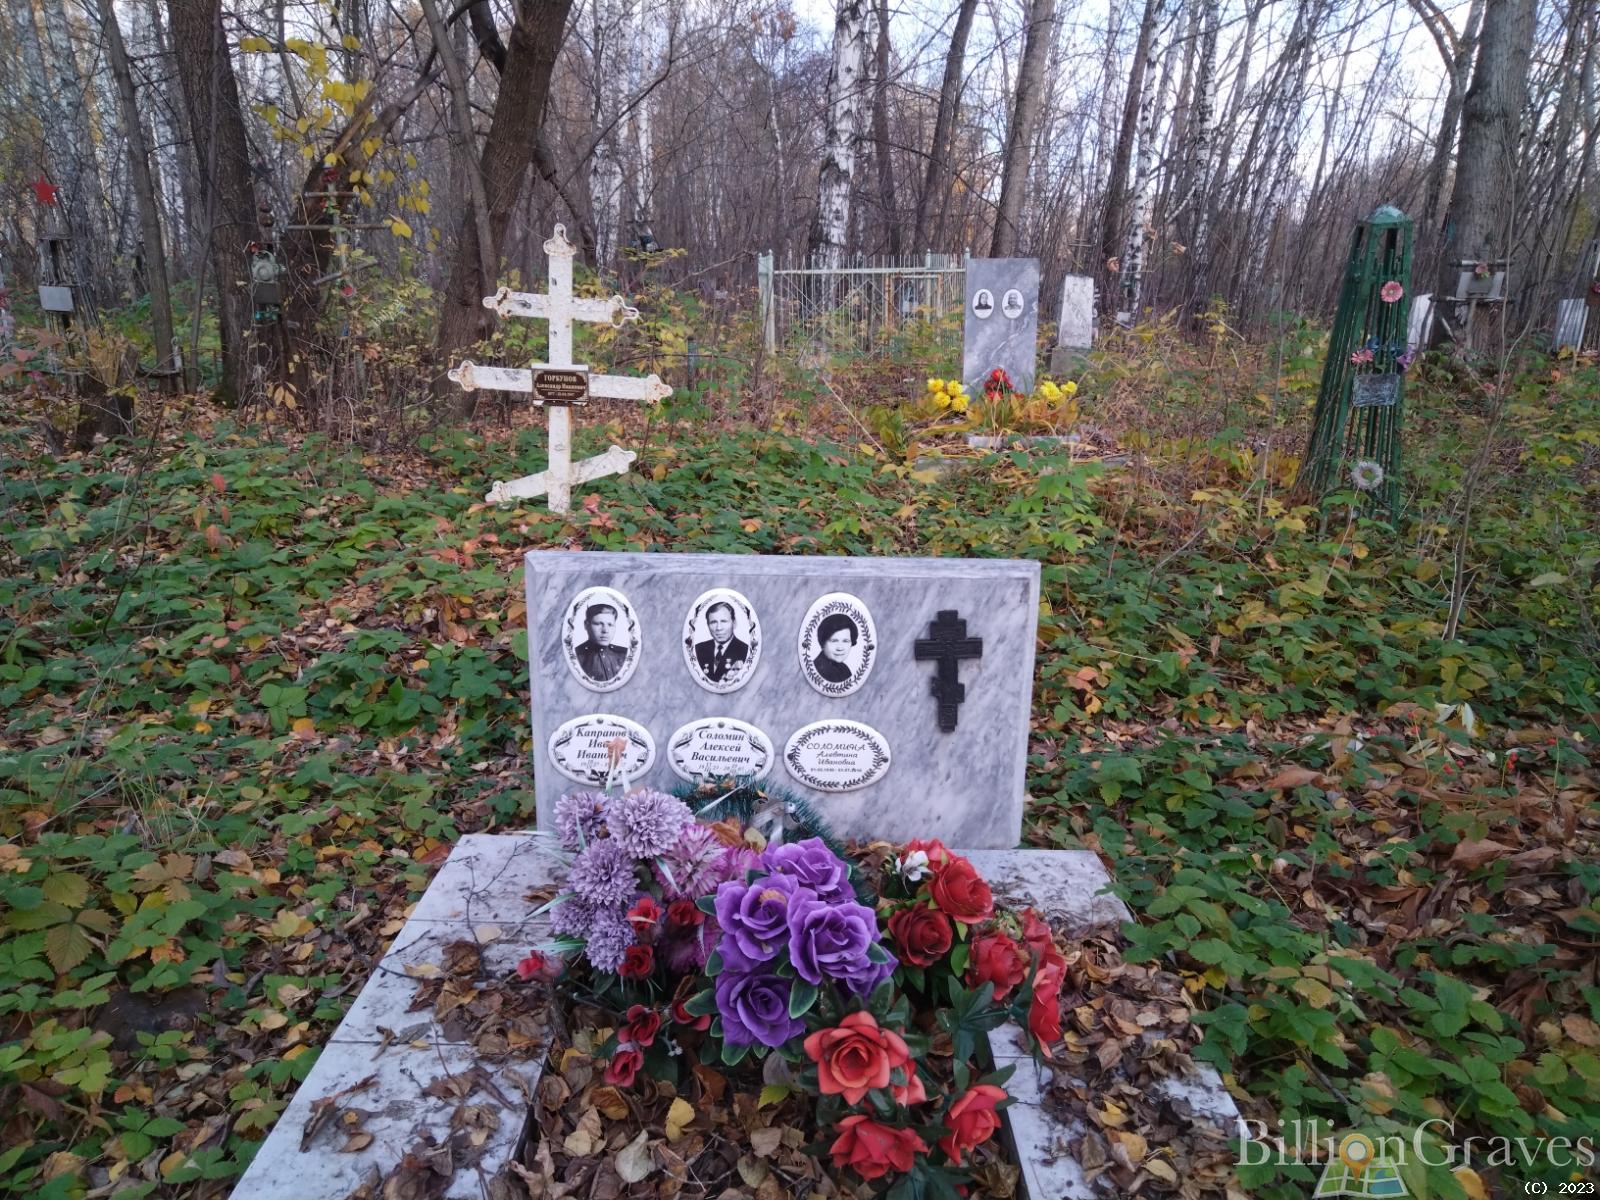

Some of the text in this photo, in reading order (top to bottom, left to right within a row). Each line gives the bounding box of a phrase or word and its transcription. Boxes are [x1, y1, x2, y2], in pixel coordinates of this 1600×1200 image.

[576, 728, 627, 739] Капранов
[698, 730, 745, 741] Соломин
[699, 742, 742, 752] Алексей
[691, 752, 750, 764] Васильевич
